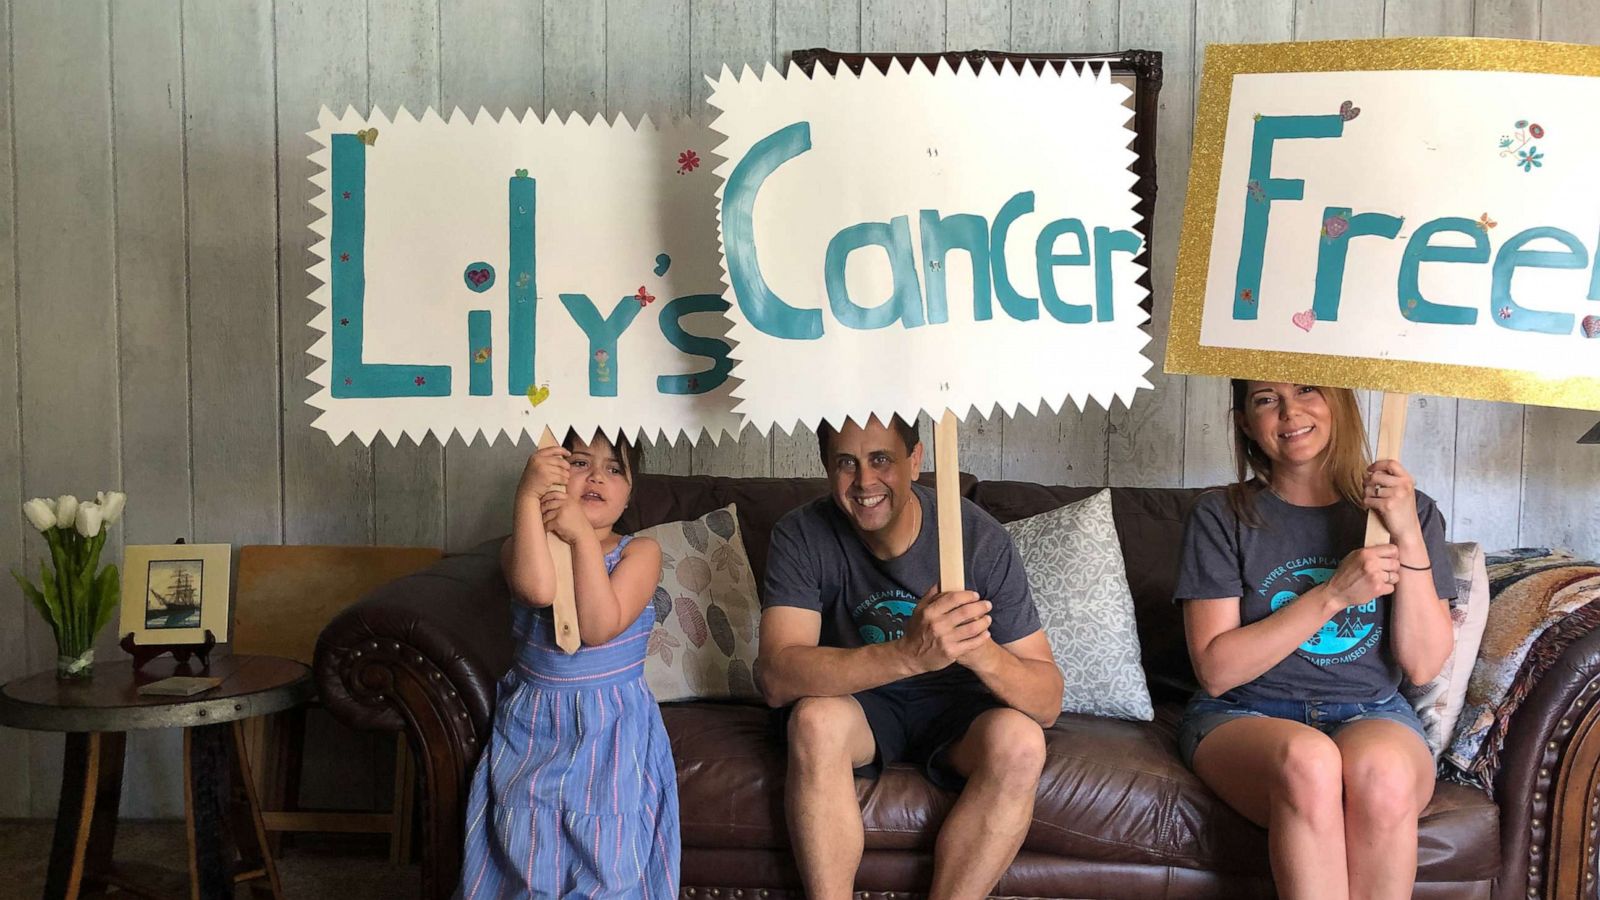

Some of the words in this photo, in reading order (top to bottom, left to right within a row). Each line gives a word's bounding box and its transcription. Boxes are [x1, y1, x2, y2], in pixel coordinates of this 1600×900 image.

[721, 120, 1145, 341] Cancer
[1286, 556, 1316, 570] CLEAN
[1318, 556, 1341, 566] PLA
[1262, 566, 1287, 589] HYPER
[853, 598, 872, 617] YPER
[895, 589, 916, 600] PLA
[1258, 588, 1268, 597] A
[1297, 646, 1367, 667] OMPROMISED
